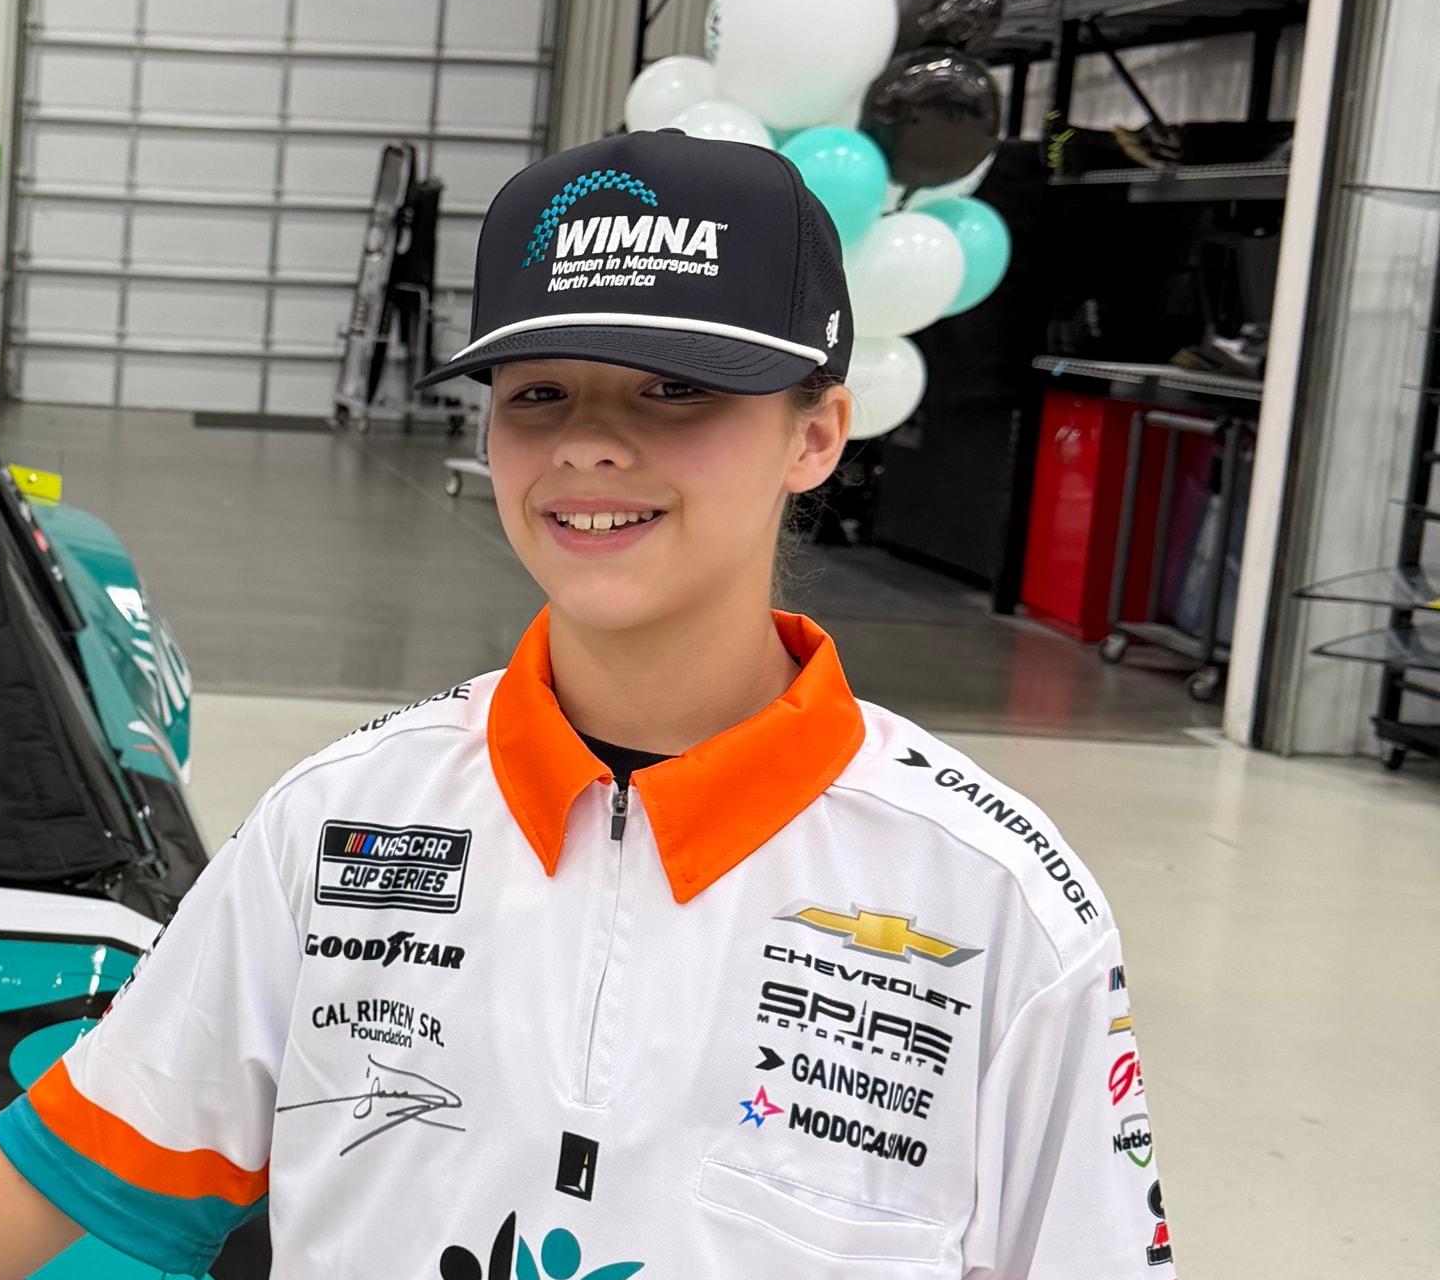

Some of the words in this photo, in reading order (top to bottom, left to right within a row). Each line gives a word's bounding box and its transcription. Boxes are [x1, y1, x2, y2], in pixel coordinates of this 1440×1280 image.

[555, 215, 718, 259] WIMNA
[548, 273, 588, 292] North
[590, 271, 656, 287] America
[551, 260, 602, 276] Women
[606, 256, 620, 271] in
[623, 256, 719, 277] Motorsports
[371, 836, 452, 859] NASCAR
[934, 768, 1099, 925] GAINBRIDGE
[340, 866, 378, 887] CUP
[379, 868, 448, 893] SERIES
[305, 931, 466, 970] GOODYEAR
[763, 944, 972, 1016] CHEVROLET
[311, 1002, 351, 1029] CAL
[357, 998, 415, 1034] RIPKEN,
[418, 1012, 445, 1048] SR.
[350, 1022, 412, 1049] Foundation
[758, 980, 953, 1065] SPIRE
[757, 1013, 945, 1076] MOTORSPORTS
[791, 1053, 934, 1120] GAINBRIDGE
[1113, 1129, 1152, 1153] Natio
